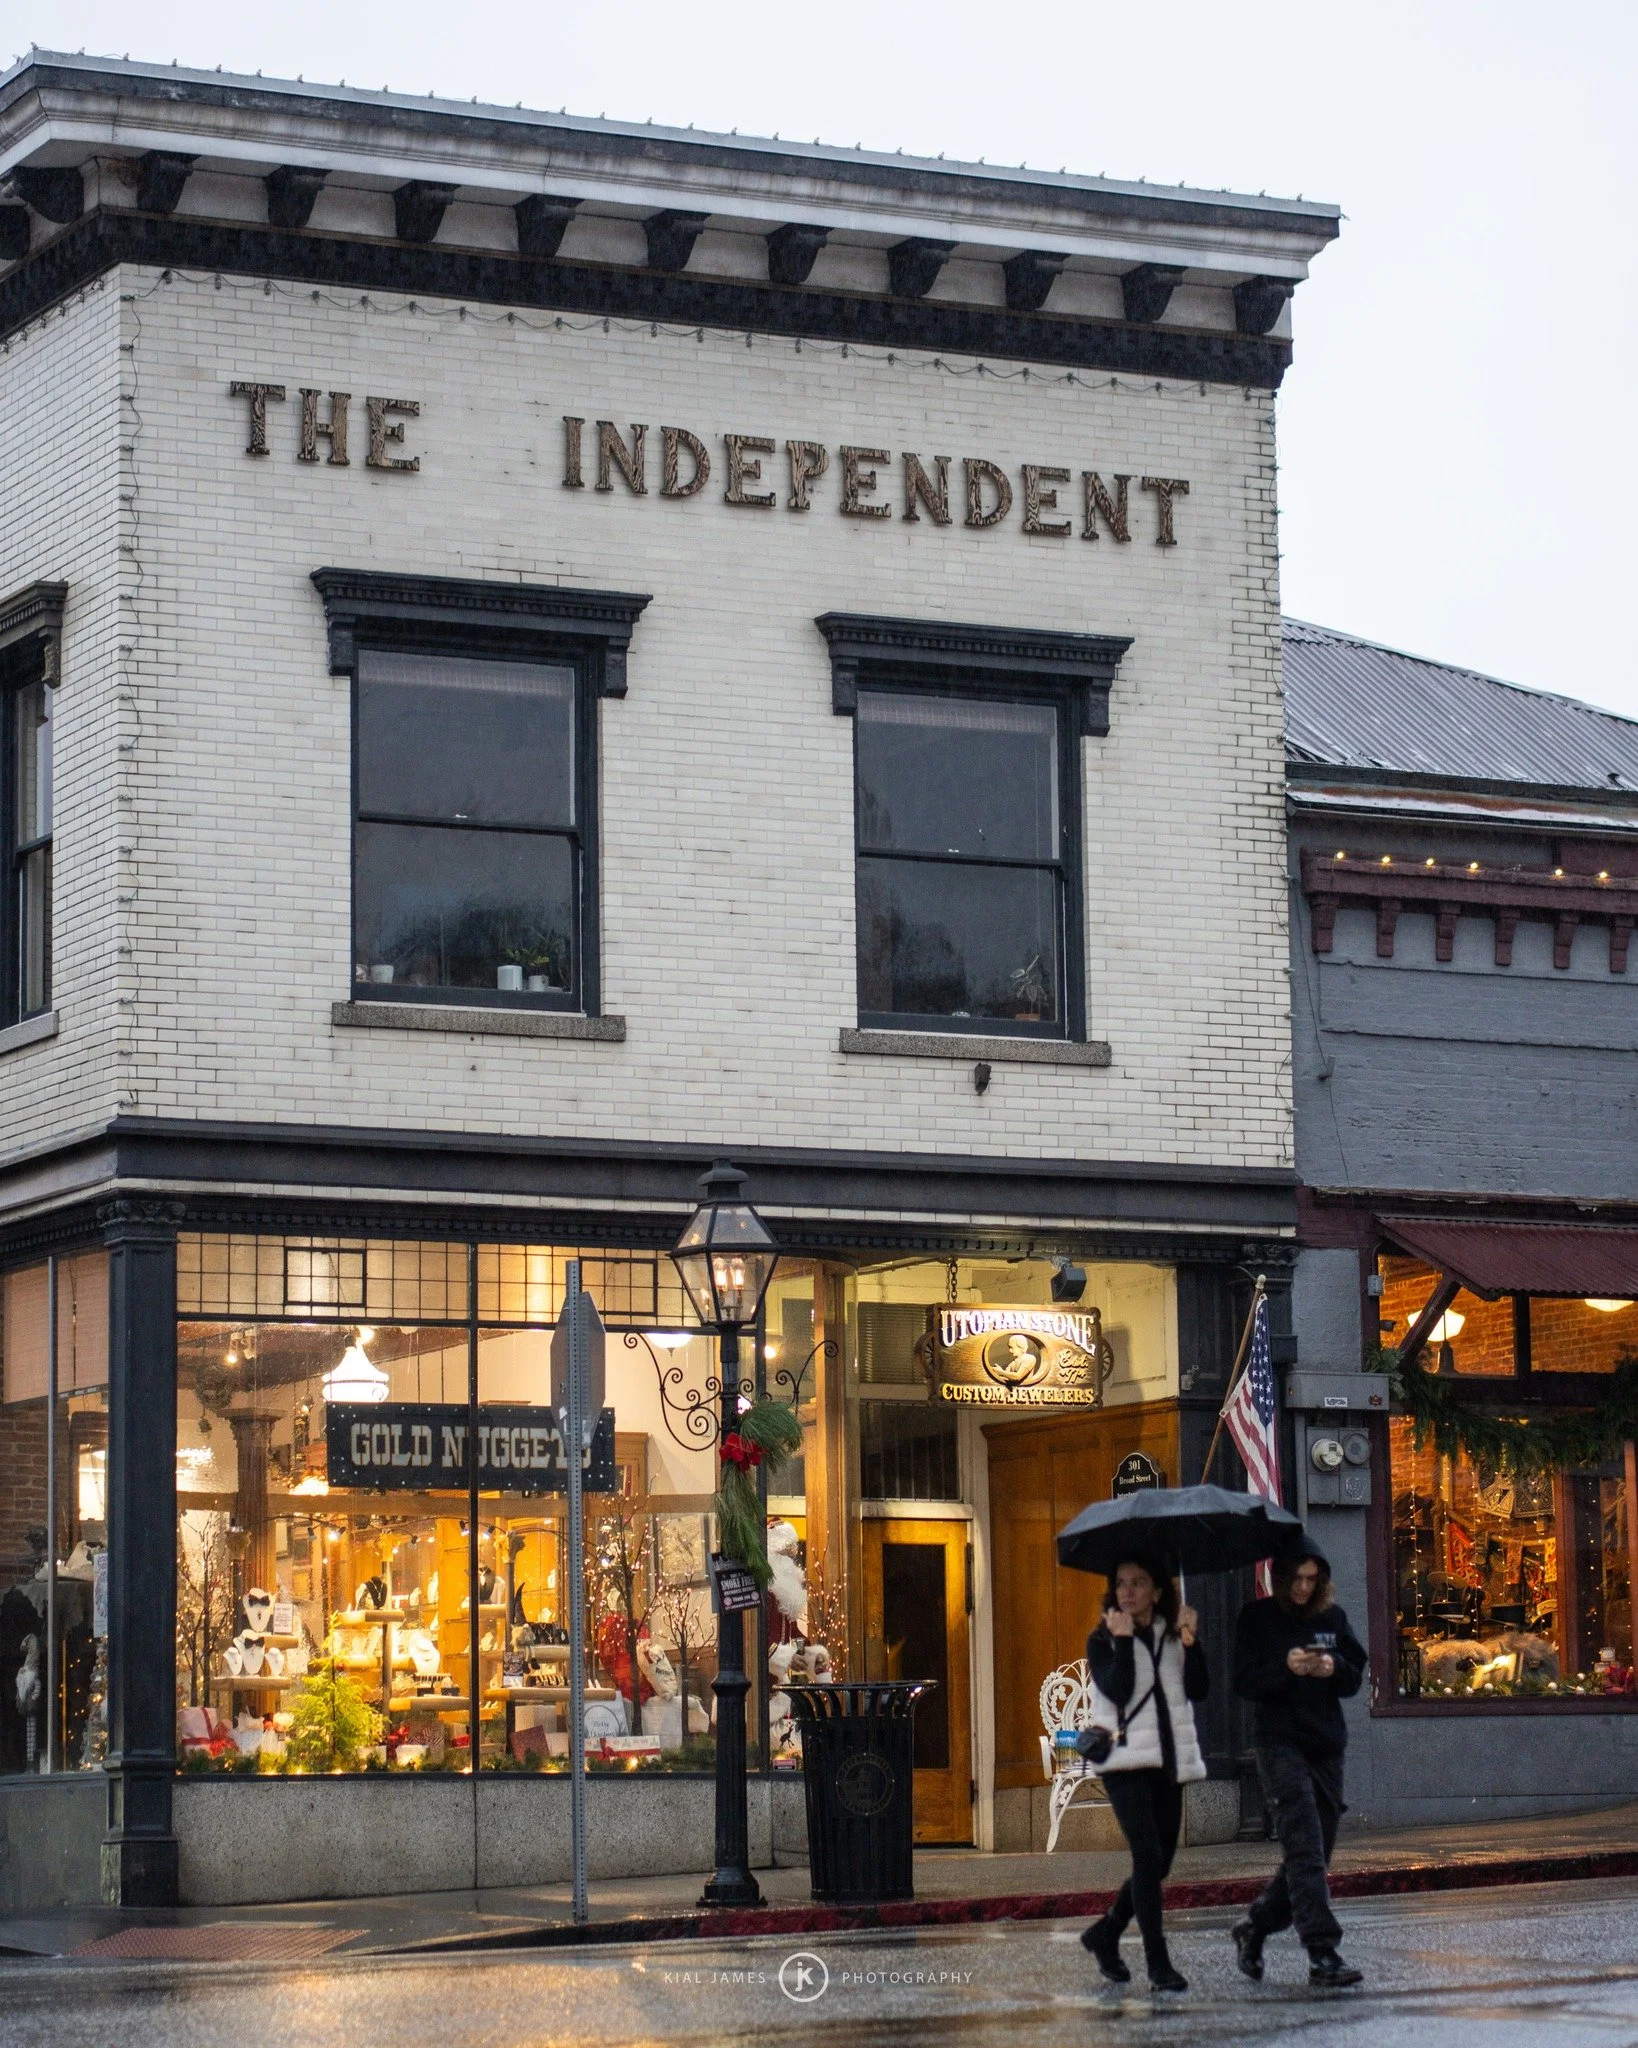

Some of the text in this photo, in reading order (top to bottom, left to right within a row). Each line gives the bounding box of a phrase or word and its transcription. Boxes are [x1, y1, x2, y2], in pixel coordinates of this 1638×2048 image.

[230, 380, 1190, 546] THE INDEPENDENT
[940, 1310, 1096, 1356] UTOPIAN STONE
[941, 1383, 1096, 1405] CUSTOM JEWELERS
[351, 1422, 432, 1467] GOLD
[1128, 1459, 1141, 1471] 301
[720, 1577, 741, 1591] SMOKE
